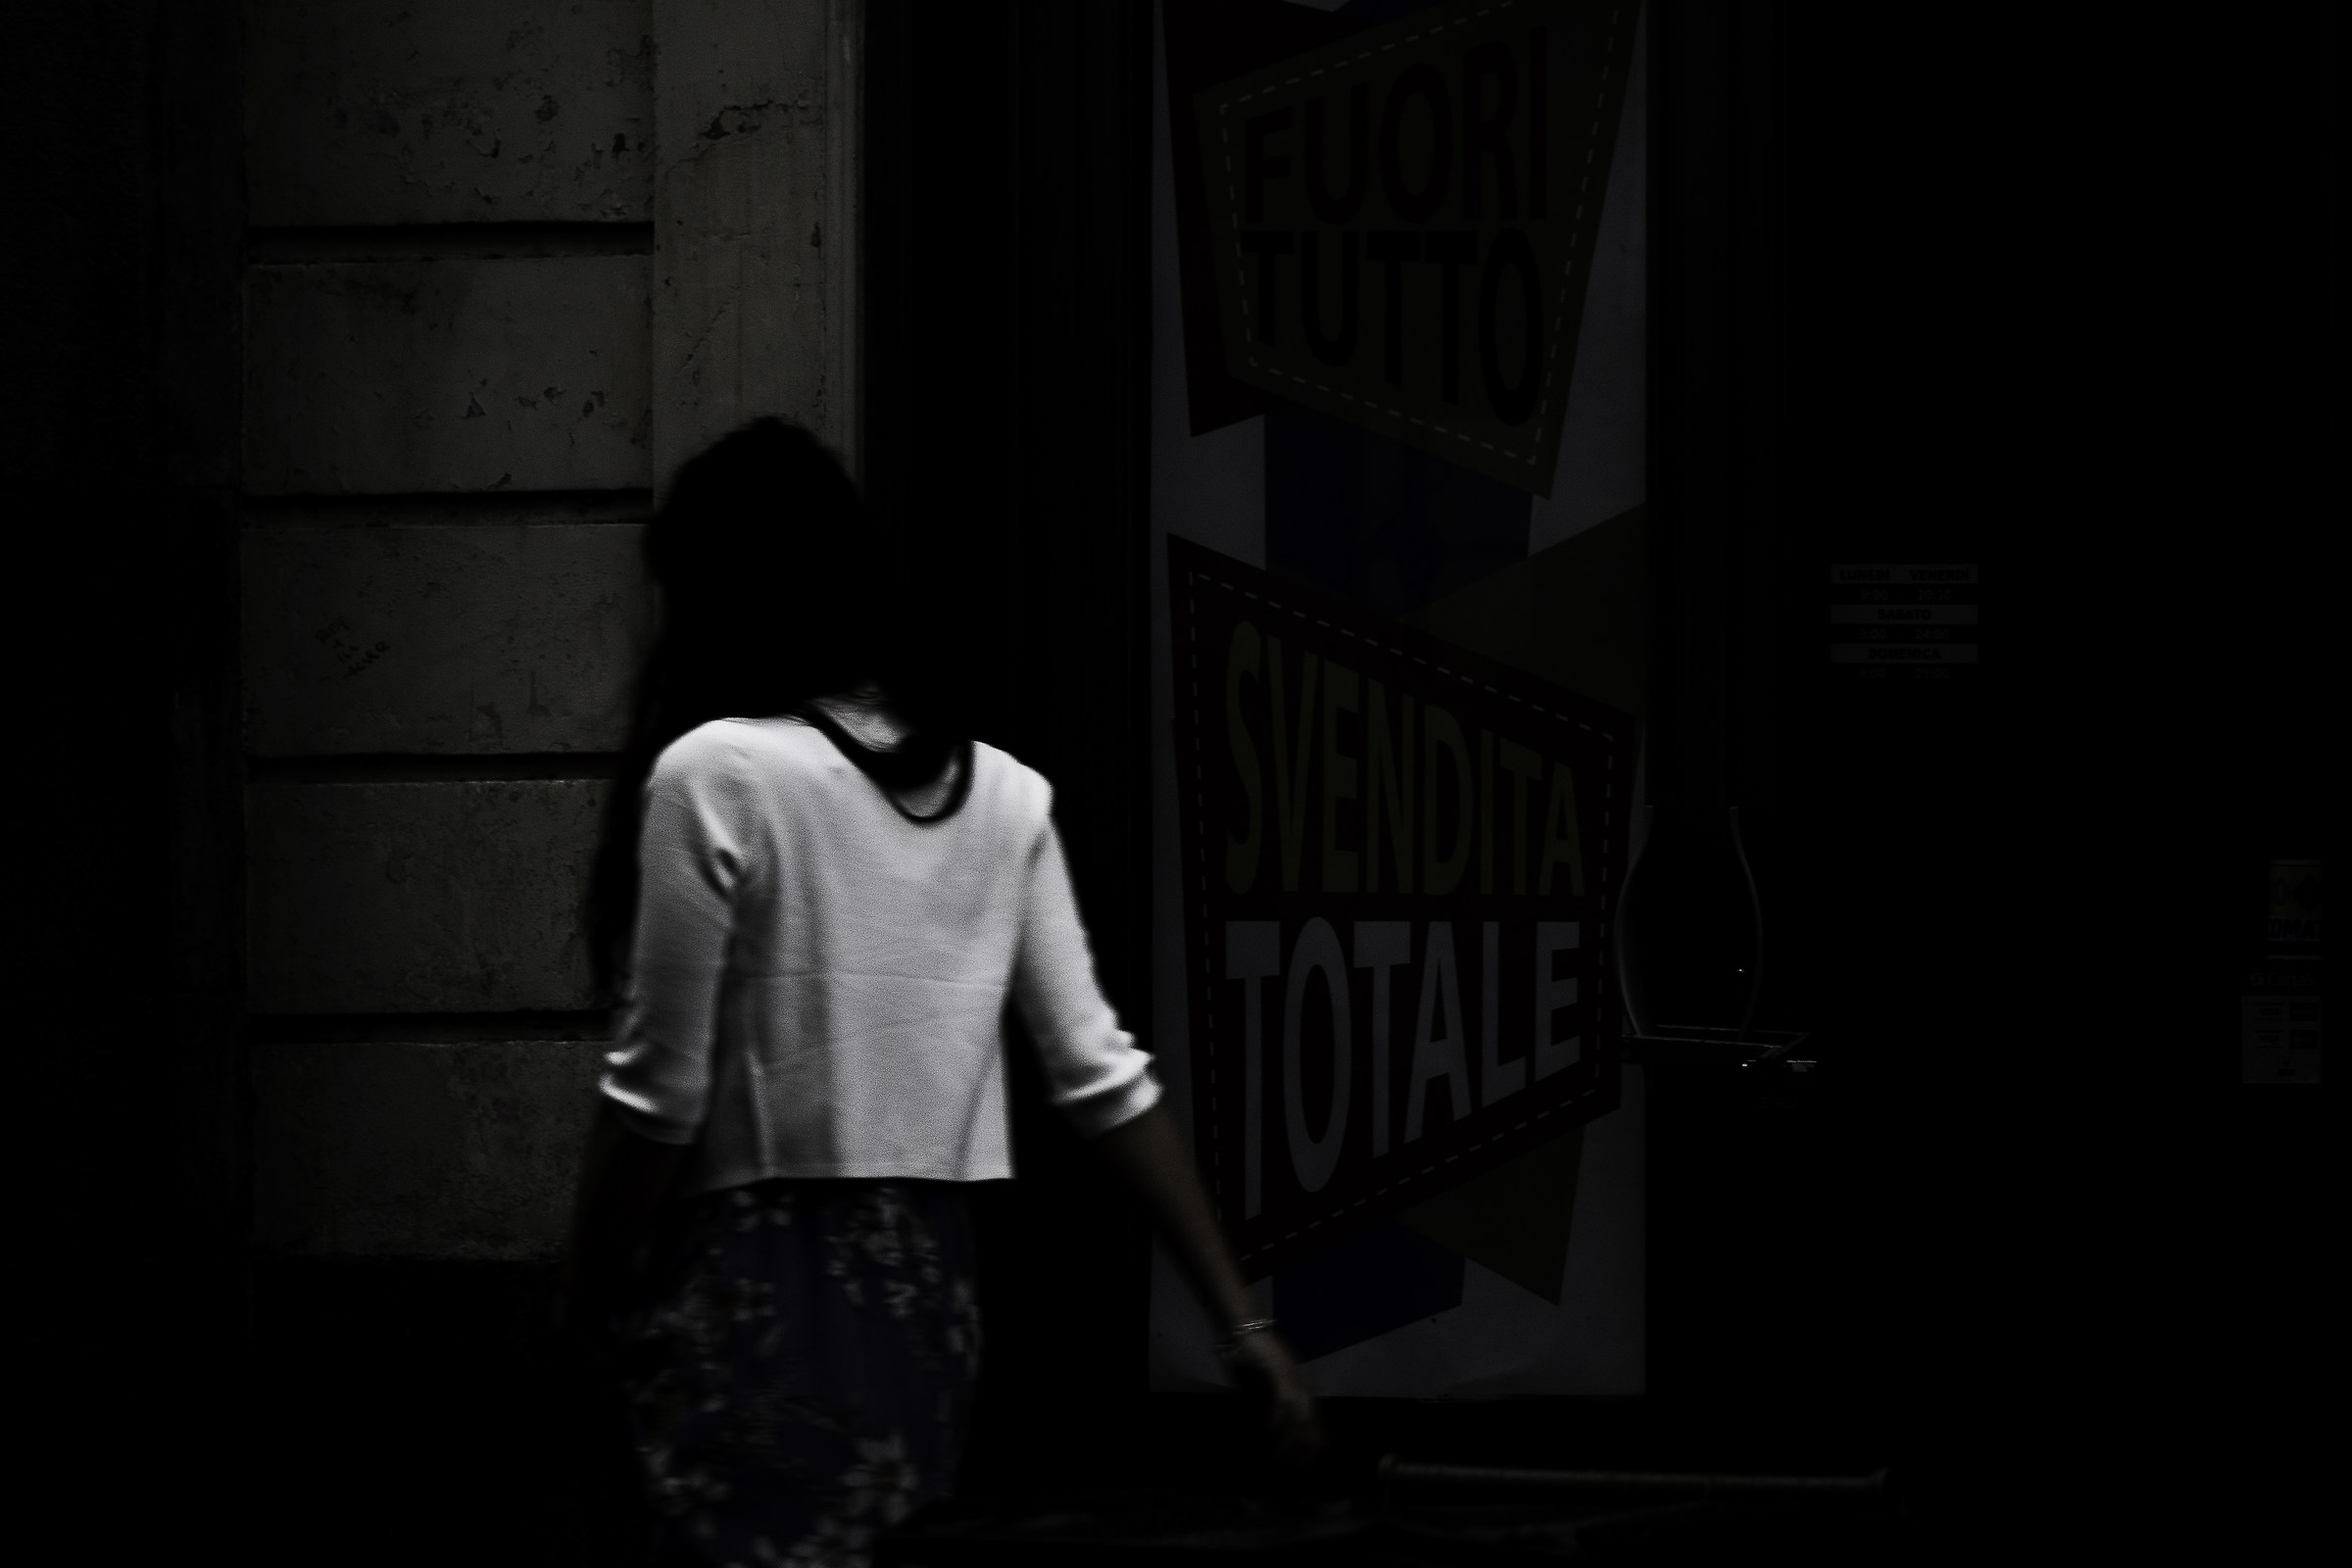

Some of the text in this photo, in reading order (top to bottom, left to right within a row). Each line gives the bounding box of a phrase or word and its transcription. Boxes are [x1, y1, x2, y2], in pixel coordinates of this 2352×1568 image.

[1246, 25, 1547, 224] FUORI
[1241, 227, 1544, 427] TUTTO
[1916, 589, 1952, 601] 20:30
[1877, 609, 1933, 620] SABATO
[1914, 628, 1950, 640] 24:00
[1868, 648, 1941, 660] DOMENICA
[1914, 667, 1950, 679] 21:00
[1225, 620, 1586, 897] SVENDITA
[1225, 916, 1582, 1220] TOTALE
